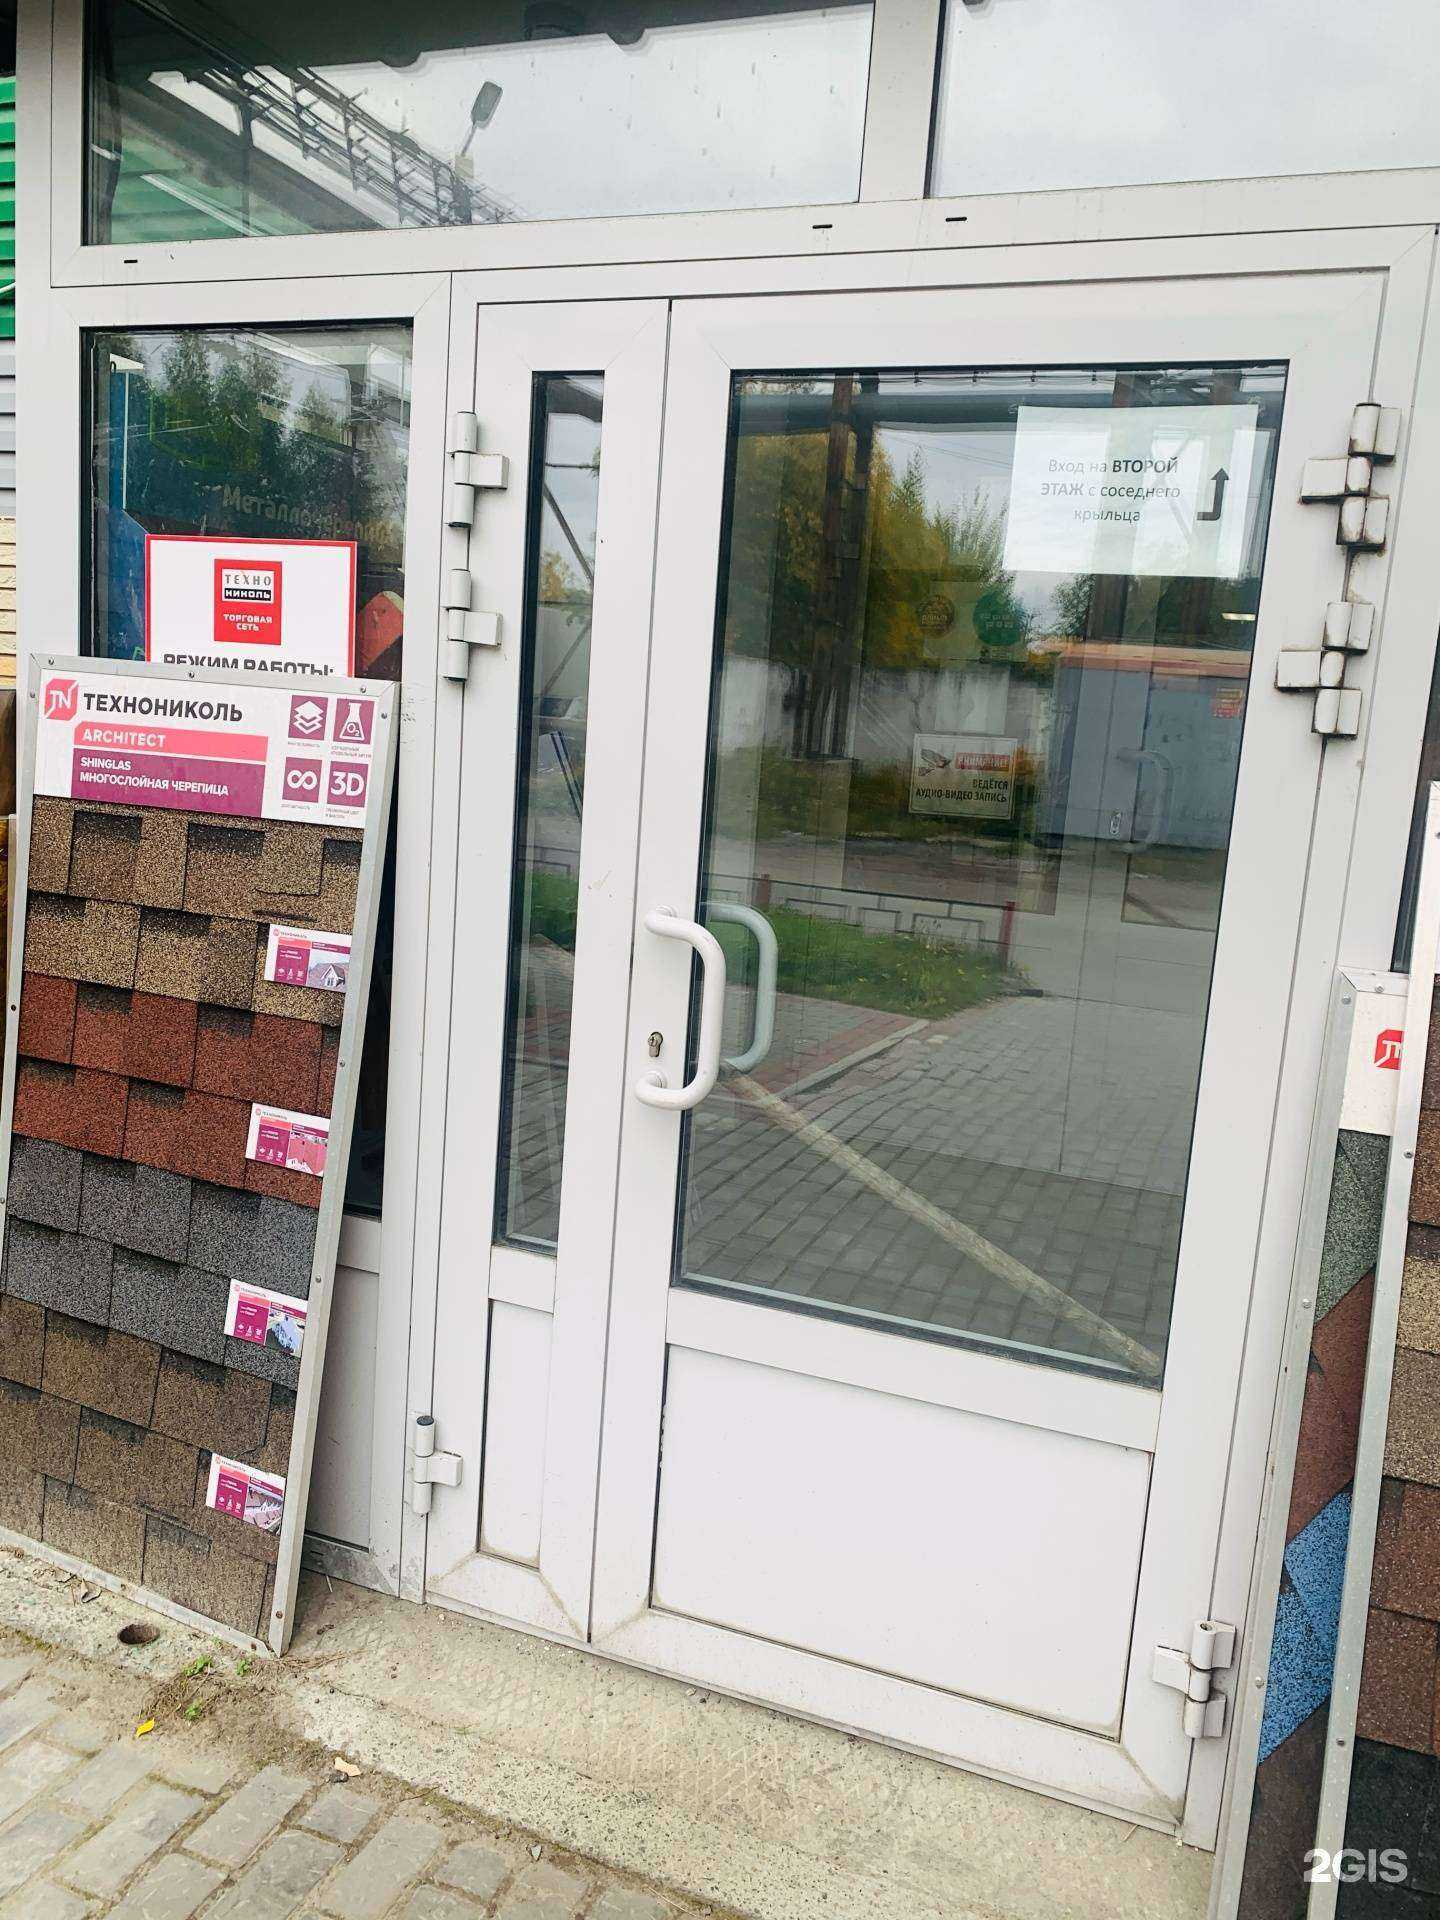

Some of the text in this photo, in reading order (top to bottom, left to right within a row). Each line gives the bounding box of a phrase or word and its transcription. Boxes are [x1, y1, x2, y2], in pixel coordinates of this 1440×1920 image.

[1049, 457, 1178, 474] Вход на ВТОРОЙ
[1041, 482, 1180, 500] ЭТАЖ с соседнего
[1074, 509, 1141, 524] крыльца
[225, 574, 271, 586] ТЕХНО
[225, 588, 271, 600] НИКОЛЬ
[223, 613, 273, 624] ТОРГОВАЯ
[236, 622, 259, 631] СЕТЬ
[83, 692, 243, 722] ТЕХНОНИКОЛЬ
[82, 729, 166, 747] ARCHITECT
[80, 756, 132, 771] SHINGLAS
[79, 771, 229, 797] МНОГОСЛОЙНАЯ ЧЕРЕПИЦА
[330, 771, 365, 797] 3D
[916, 788, 1007, 803] АУДИО-ВИДЕО ЗАПИСЬ
